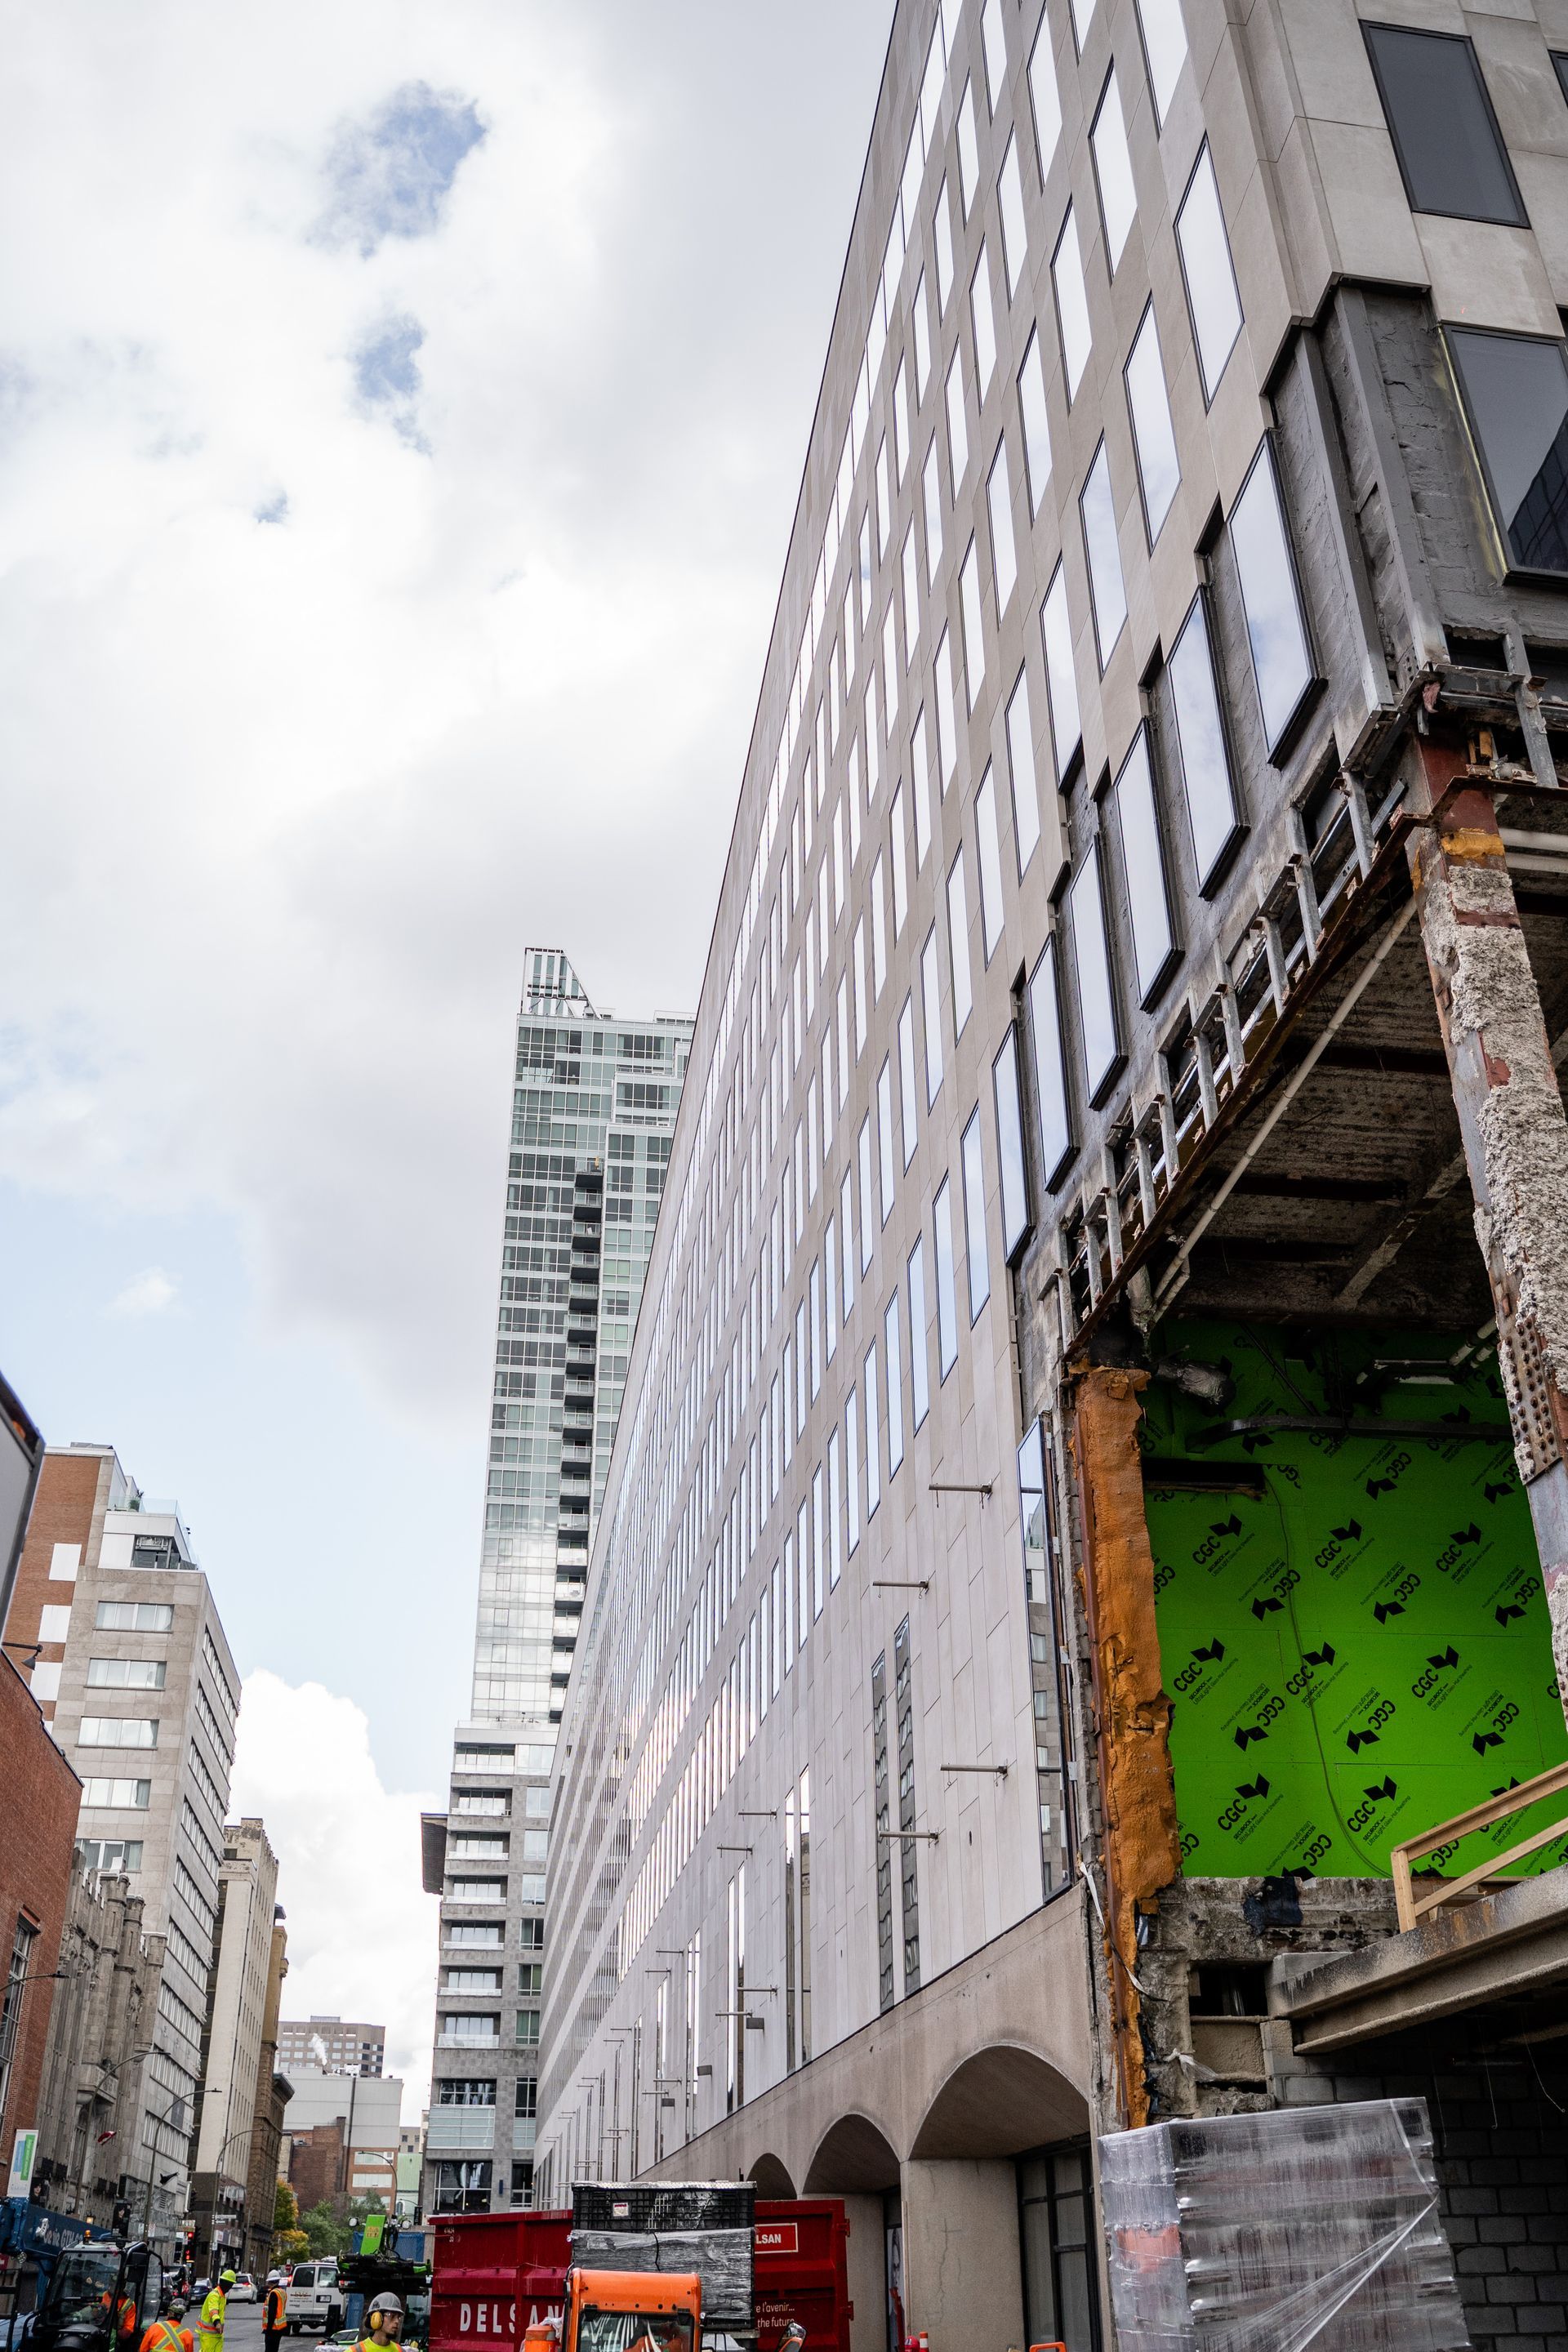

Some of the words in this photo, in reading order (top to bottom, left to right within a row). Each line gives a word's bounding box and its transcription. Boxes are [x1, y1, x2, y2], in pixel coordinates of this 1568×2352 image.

[1385, 1452, 1411, 1478] CGC
[1503, 1463, 1519, 1483] GC
[1192, 1536, 1220, 1564] CGC
[1315, 1540, 1341, 1567] CGC
[1436, 1544, 1461, 1571] CGC
[1273, 1569, 1300, 1597] CGC
[1394, 1573, 1420, 1601] CGC
[1514, 1576, 1539, 1604] CGC
[1174, 1662, 1202, 1691] CGC
[1285, 1665, 1313, 1695] CGC
[1411, 1668, 1438, 1698] CGC
[1256, 1695, 1285, 1726] CGC
[1368, 1699, 1395, 1730] CGC
[1492, 1702, 1519, 1731] CGC
[1218, 1799, 1246, 1830] CGC
[1347, 1801, 1375, 1832] CGC
[1180, 1833, 1199, 1857] CG
[1303, 1834, 1331, 1865] CGC
[755, 2234, 782, 2244] LSAN
[757, 2318, 770, 2328] the
